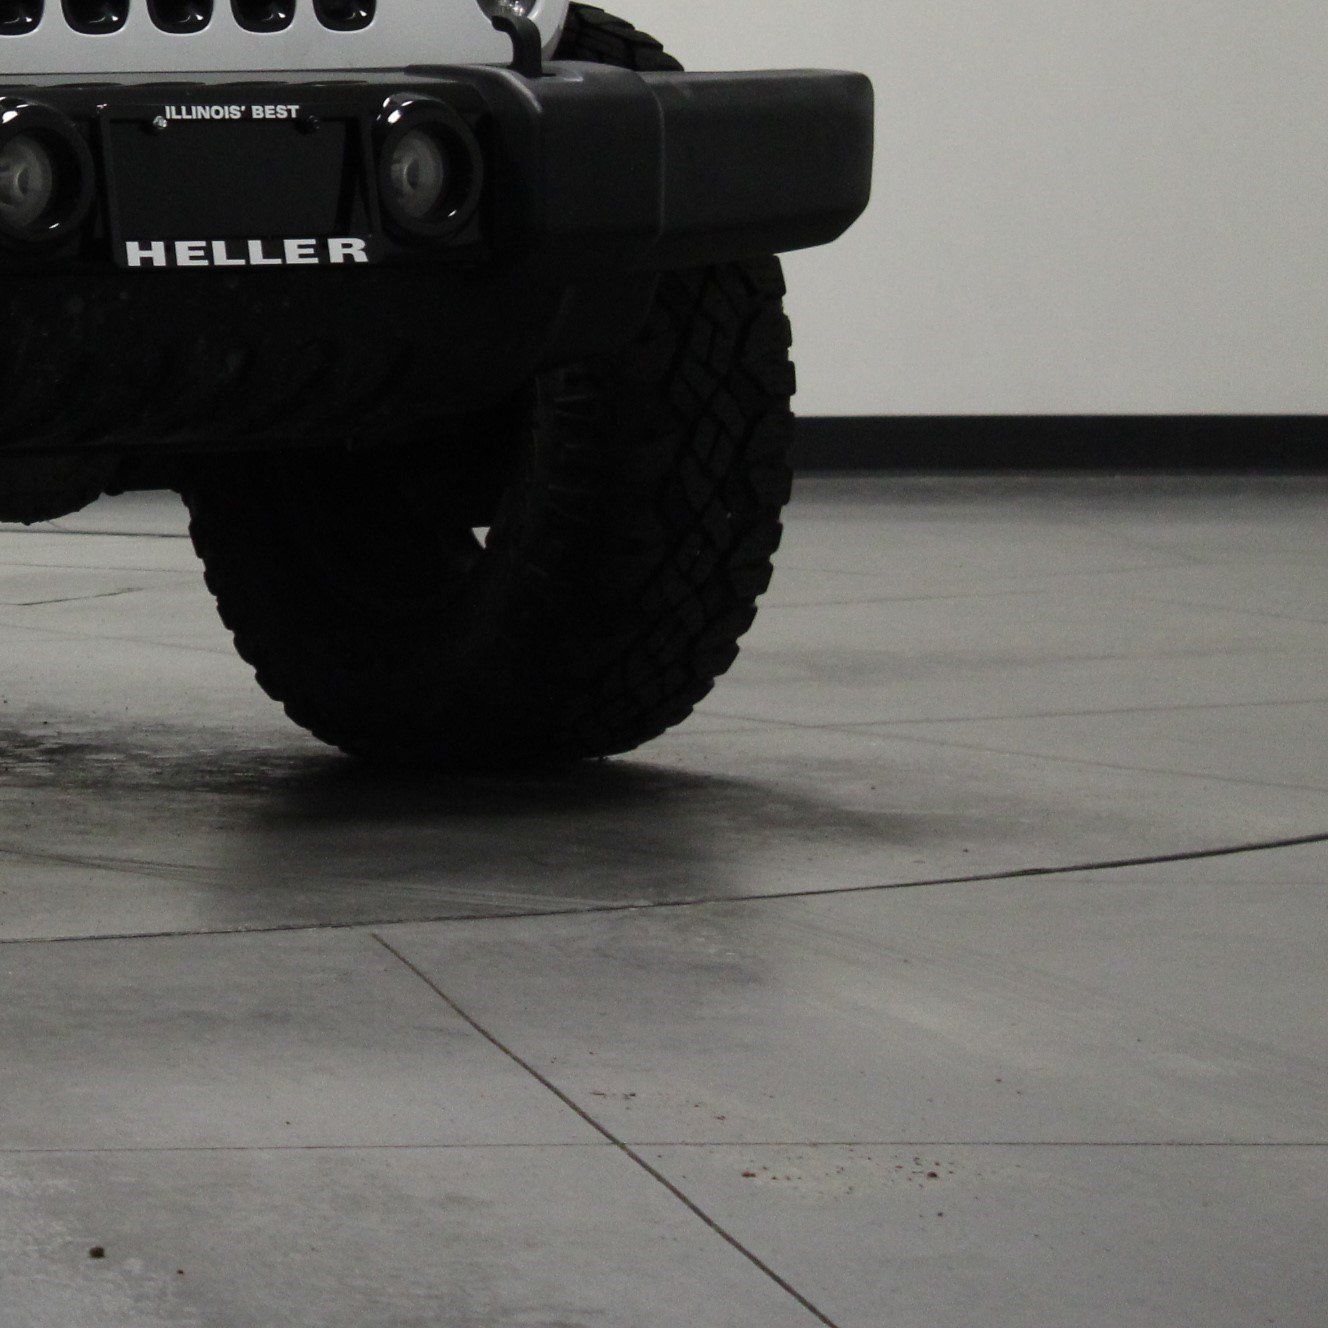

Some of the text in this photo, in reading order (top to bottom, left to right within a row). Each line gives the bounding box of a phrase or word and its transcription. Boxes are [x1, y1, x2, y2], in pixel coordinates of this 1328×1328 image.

[165, 104, 300, 120] ILLINOIS' BEST
[125, 237, 369, 267] HELLER
